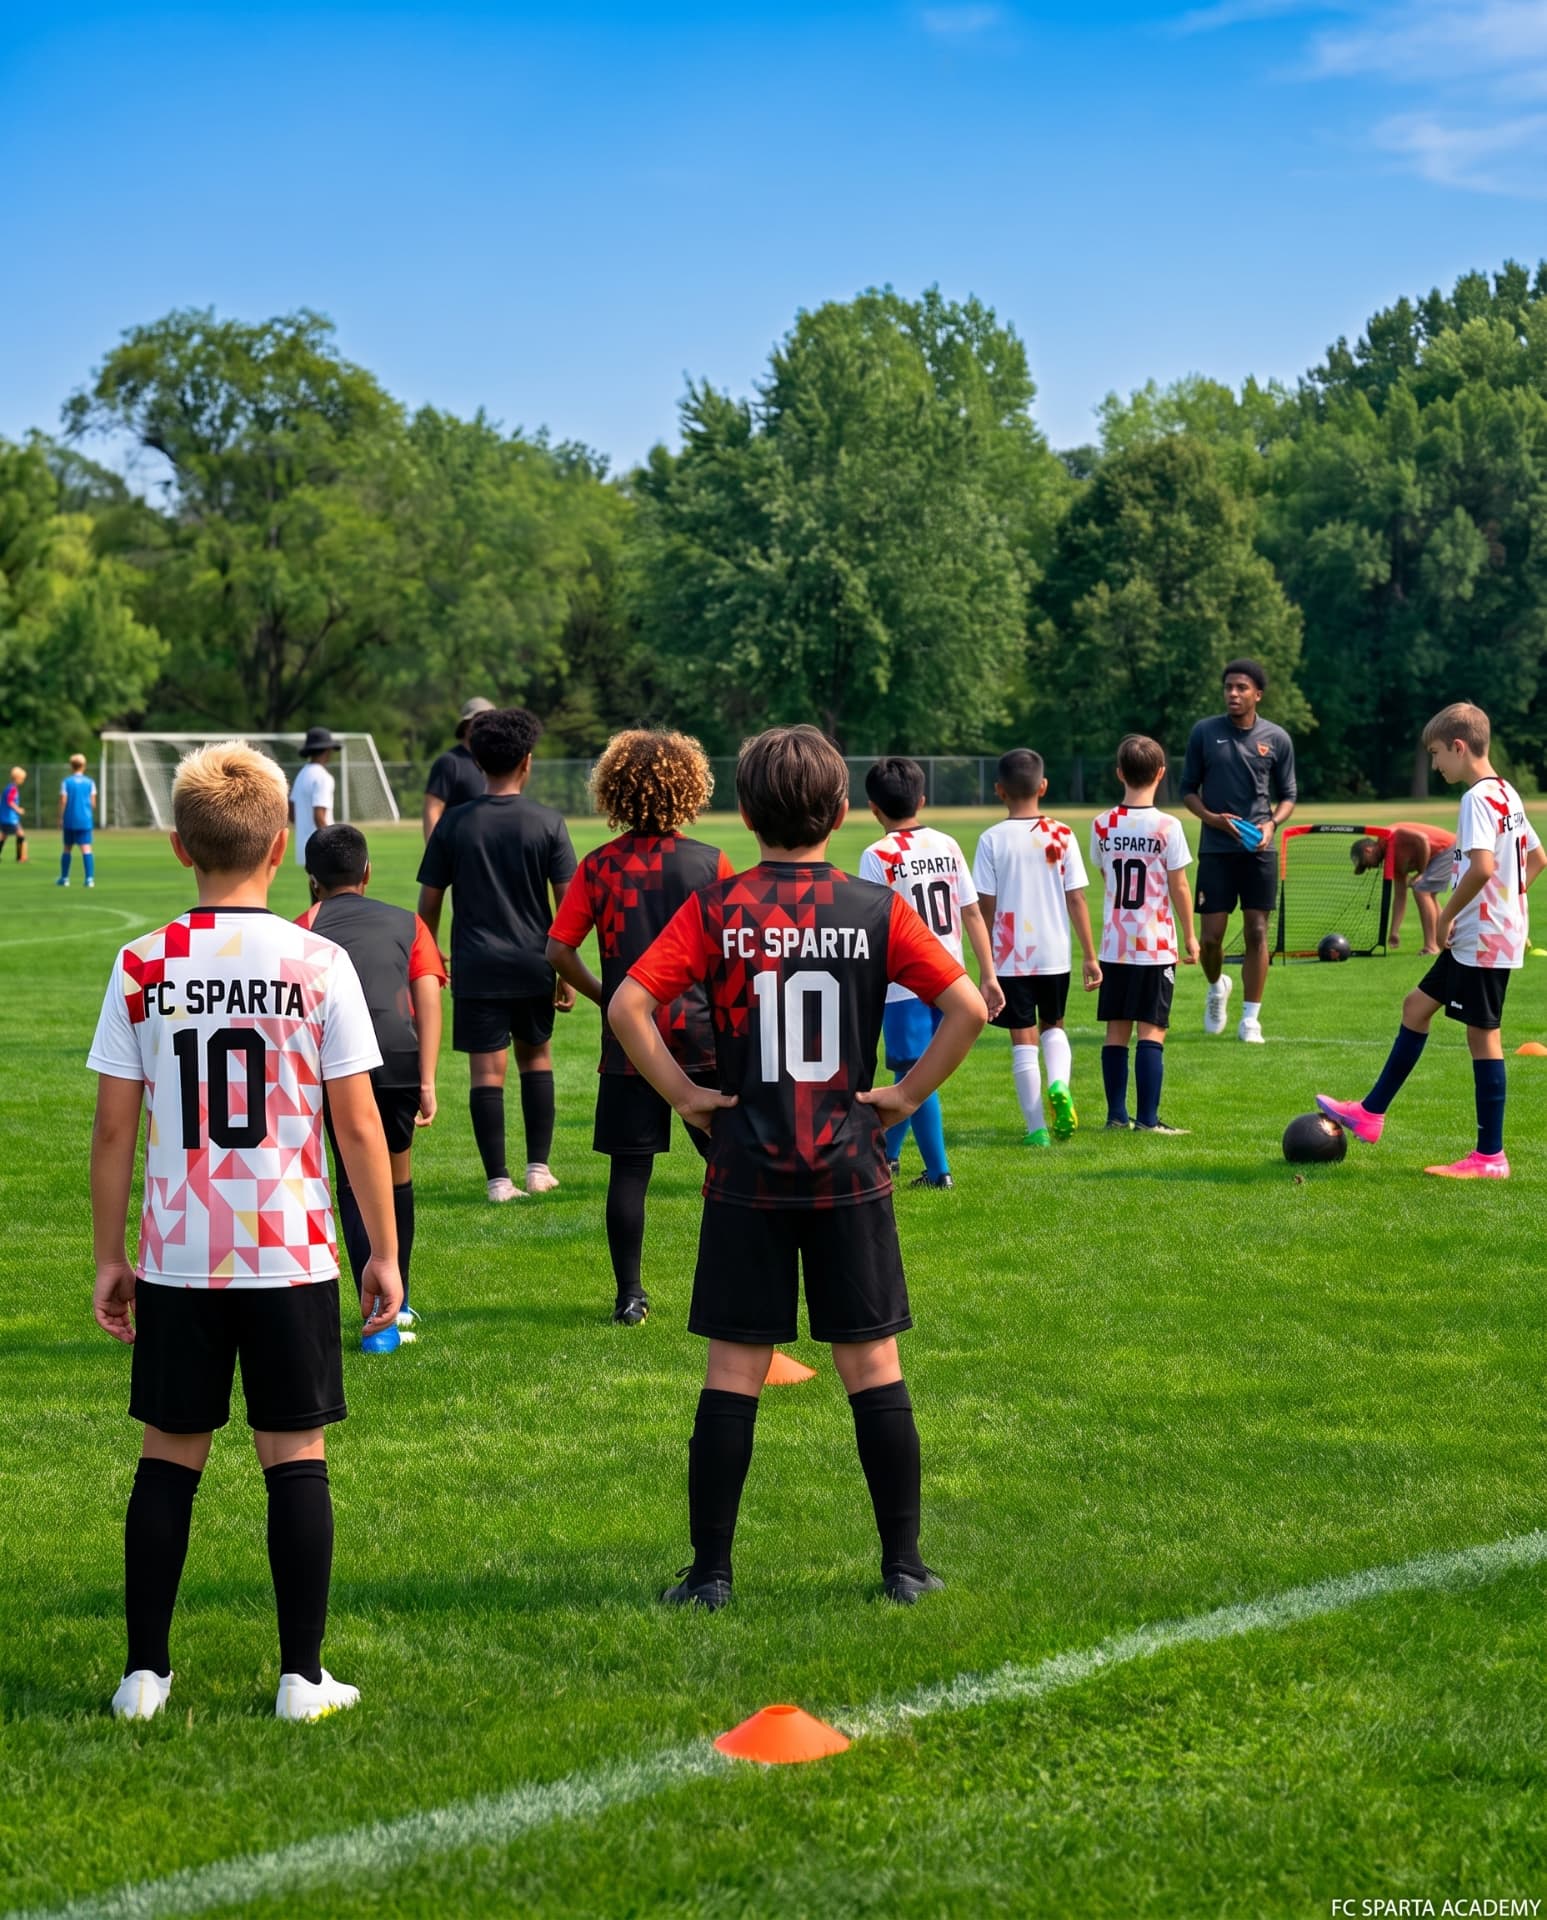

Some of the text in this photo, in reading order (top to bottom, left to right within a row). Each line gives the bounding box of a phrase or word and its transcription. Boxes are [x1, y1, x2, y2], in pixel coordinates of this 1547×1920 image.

[1114, 837, 1161, 854] SPARTA
[891, 857, 957, 881] FC SPARTA
[1112, 858, 1147, 910] 10
[911, 880, 952, 936] 10
[722, 927, 870, 960] FC SPARTA
[143, 979, 304, 1018] FC SPARTA
[753, 970, 841, 1083] 10
[173, 1027, 268, 1150] 10
